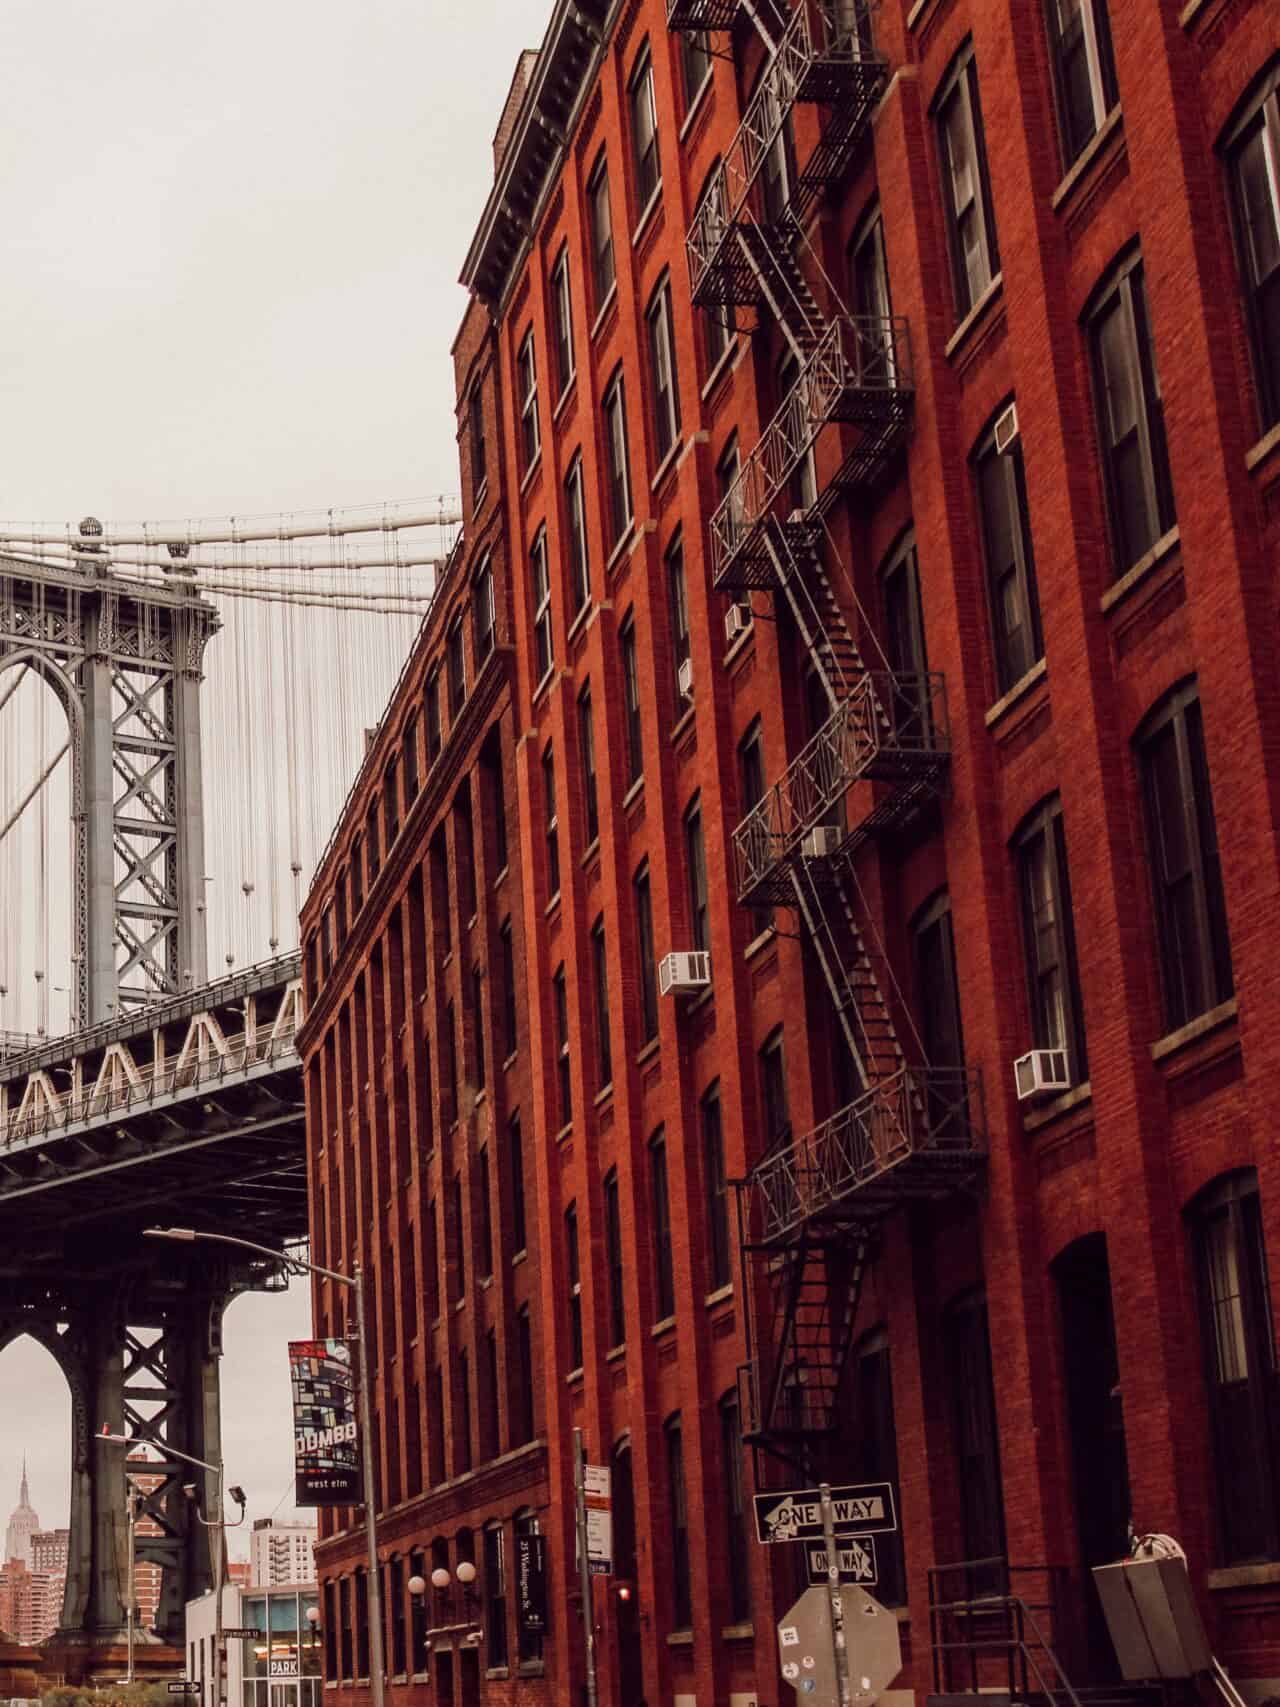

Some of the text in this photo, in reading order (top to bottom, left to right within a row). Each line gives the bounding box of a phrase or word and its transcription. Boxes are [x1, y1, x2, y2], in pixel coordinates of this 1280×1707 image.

[296, 1422, 357, 1454] DUMBO
[307, 1480, 348, 1488] west elm
[778, 1500, 874, 1525] ONE WAY
[815, 1552, 864, 1571] ON WAY
[271, 1661, 297, 1674] PARK
